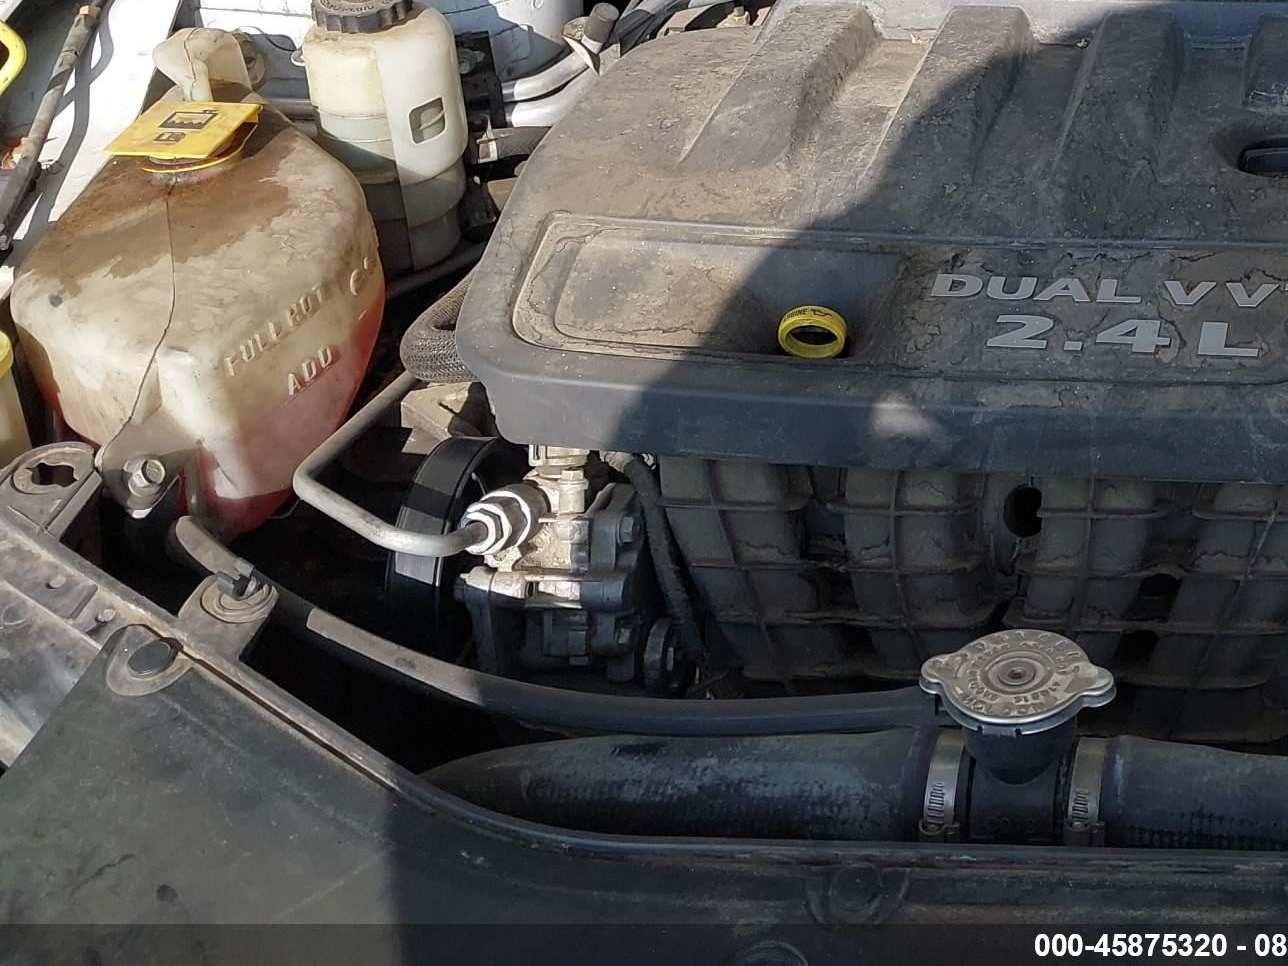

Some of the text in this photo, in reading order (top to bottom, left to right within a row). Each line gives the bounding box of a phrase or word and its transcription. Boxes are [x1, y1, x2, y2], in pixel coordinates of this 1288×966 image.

[931, 273, 1141, 304] DUAL
[223, 321, 284, 377] FULL
[986, 315, 1259, 357] 2.4 L
[287, 345, 336, 395] ADD
